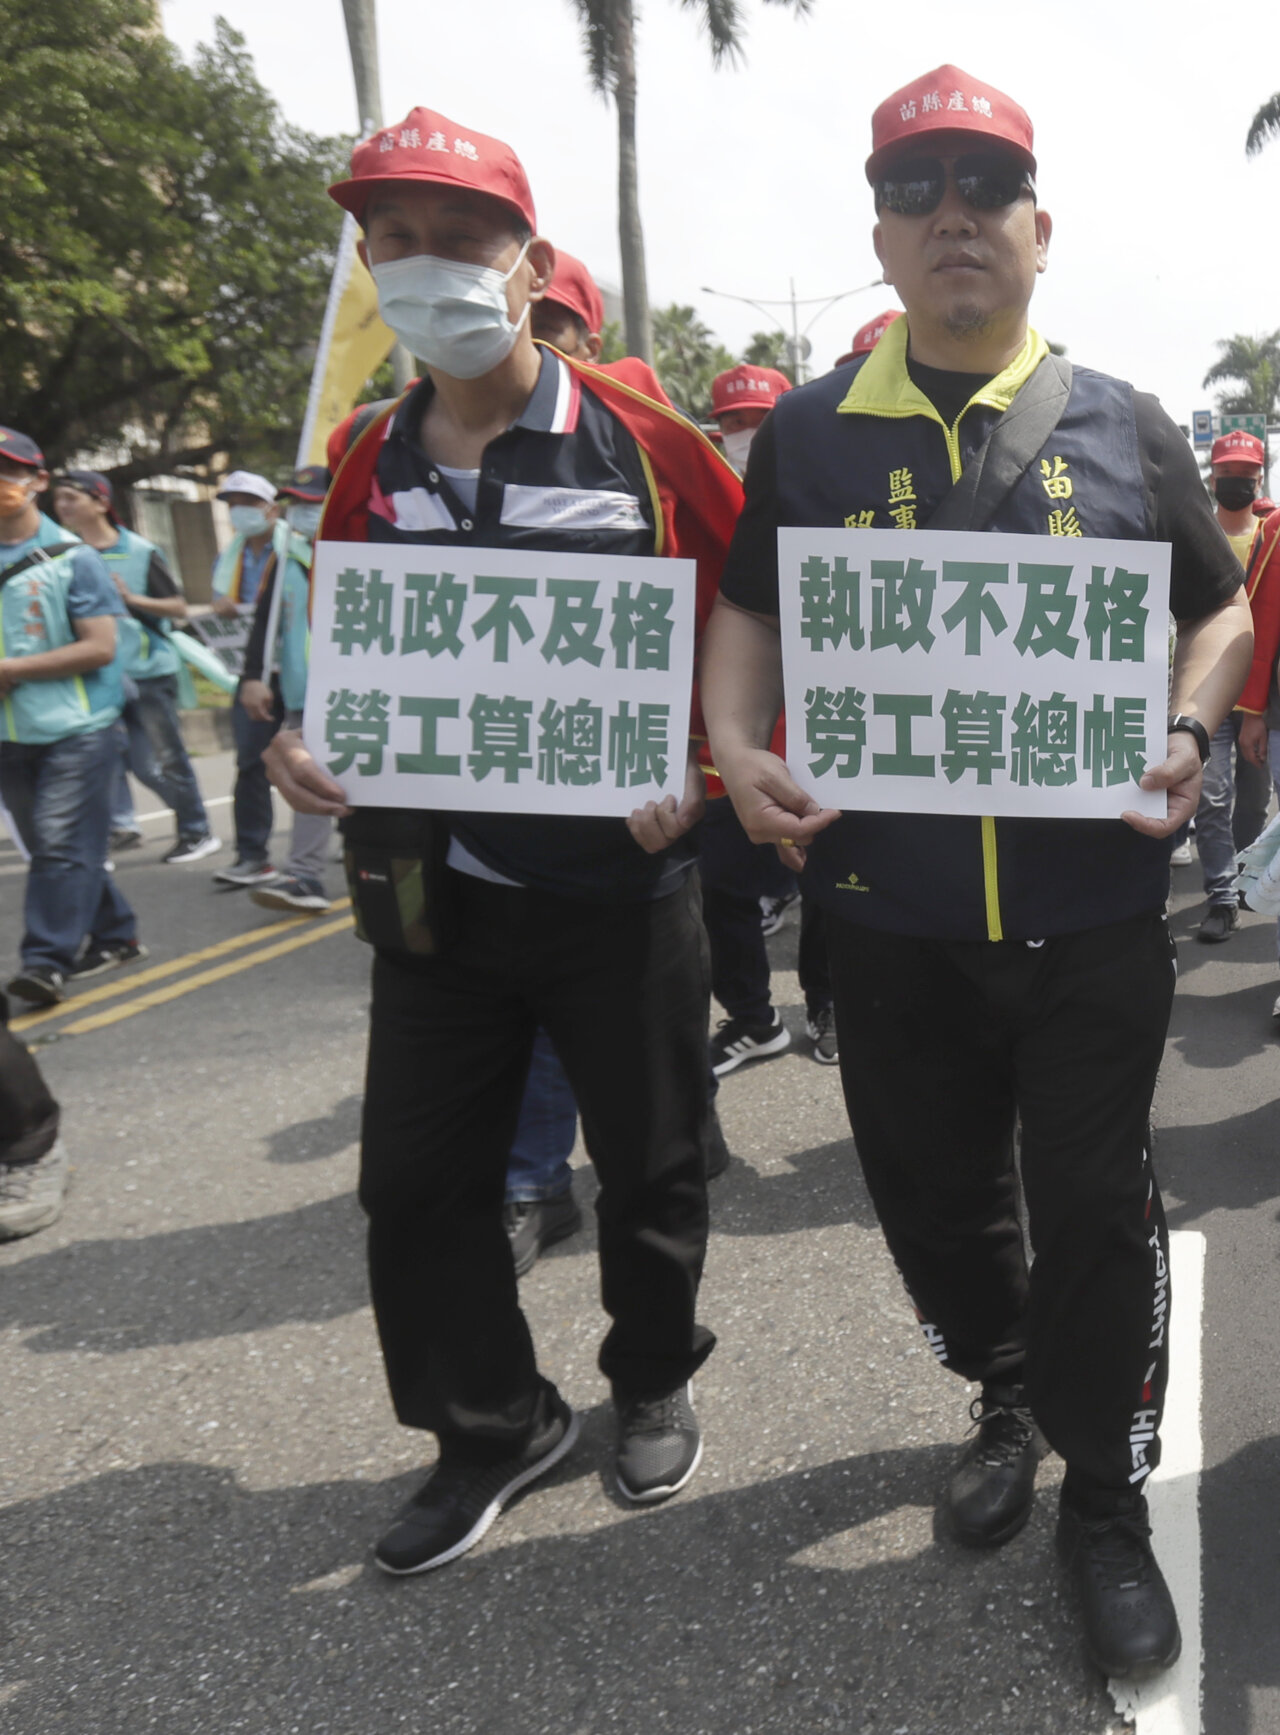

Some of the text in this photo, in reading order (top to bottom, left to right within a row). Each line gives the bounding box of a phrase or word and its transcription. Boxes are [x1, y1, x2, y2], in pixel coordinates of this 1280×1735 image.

[379, 127, 479, 162] 苗縣產總
[899, 90, 993, 122] 苗縣產總
[331, 567, 675, 672] 執政不及格
[799, 555, 1150, 663] 執政不及格
[324, 688, 671, 789] 勞工算總帳
[803, 686, 1148, 788] 勞工算總帳
[1147, 1225, 1169, 1349] TOMMY
